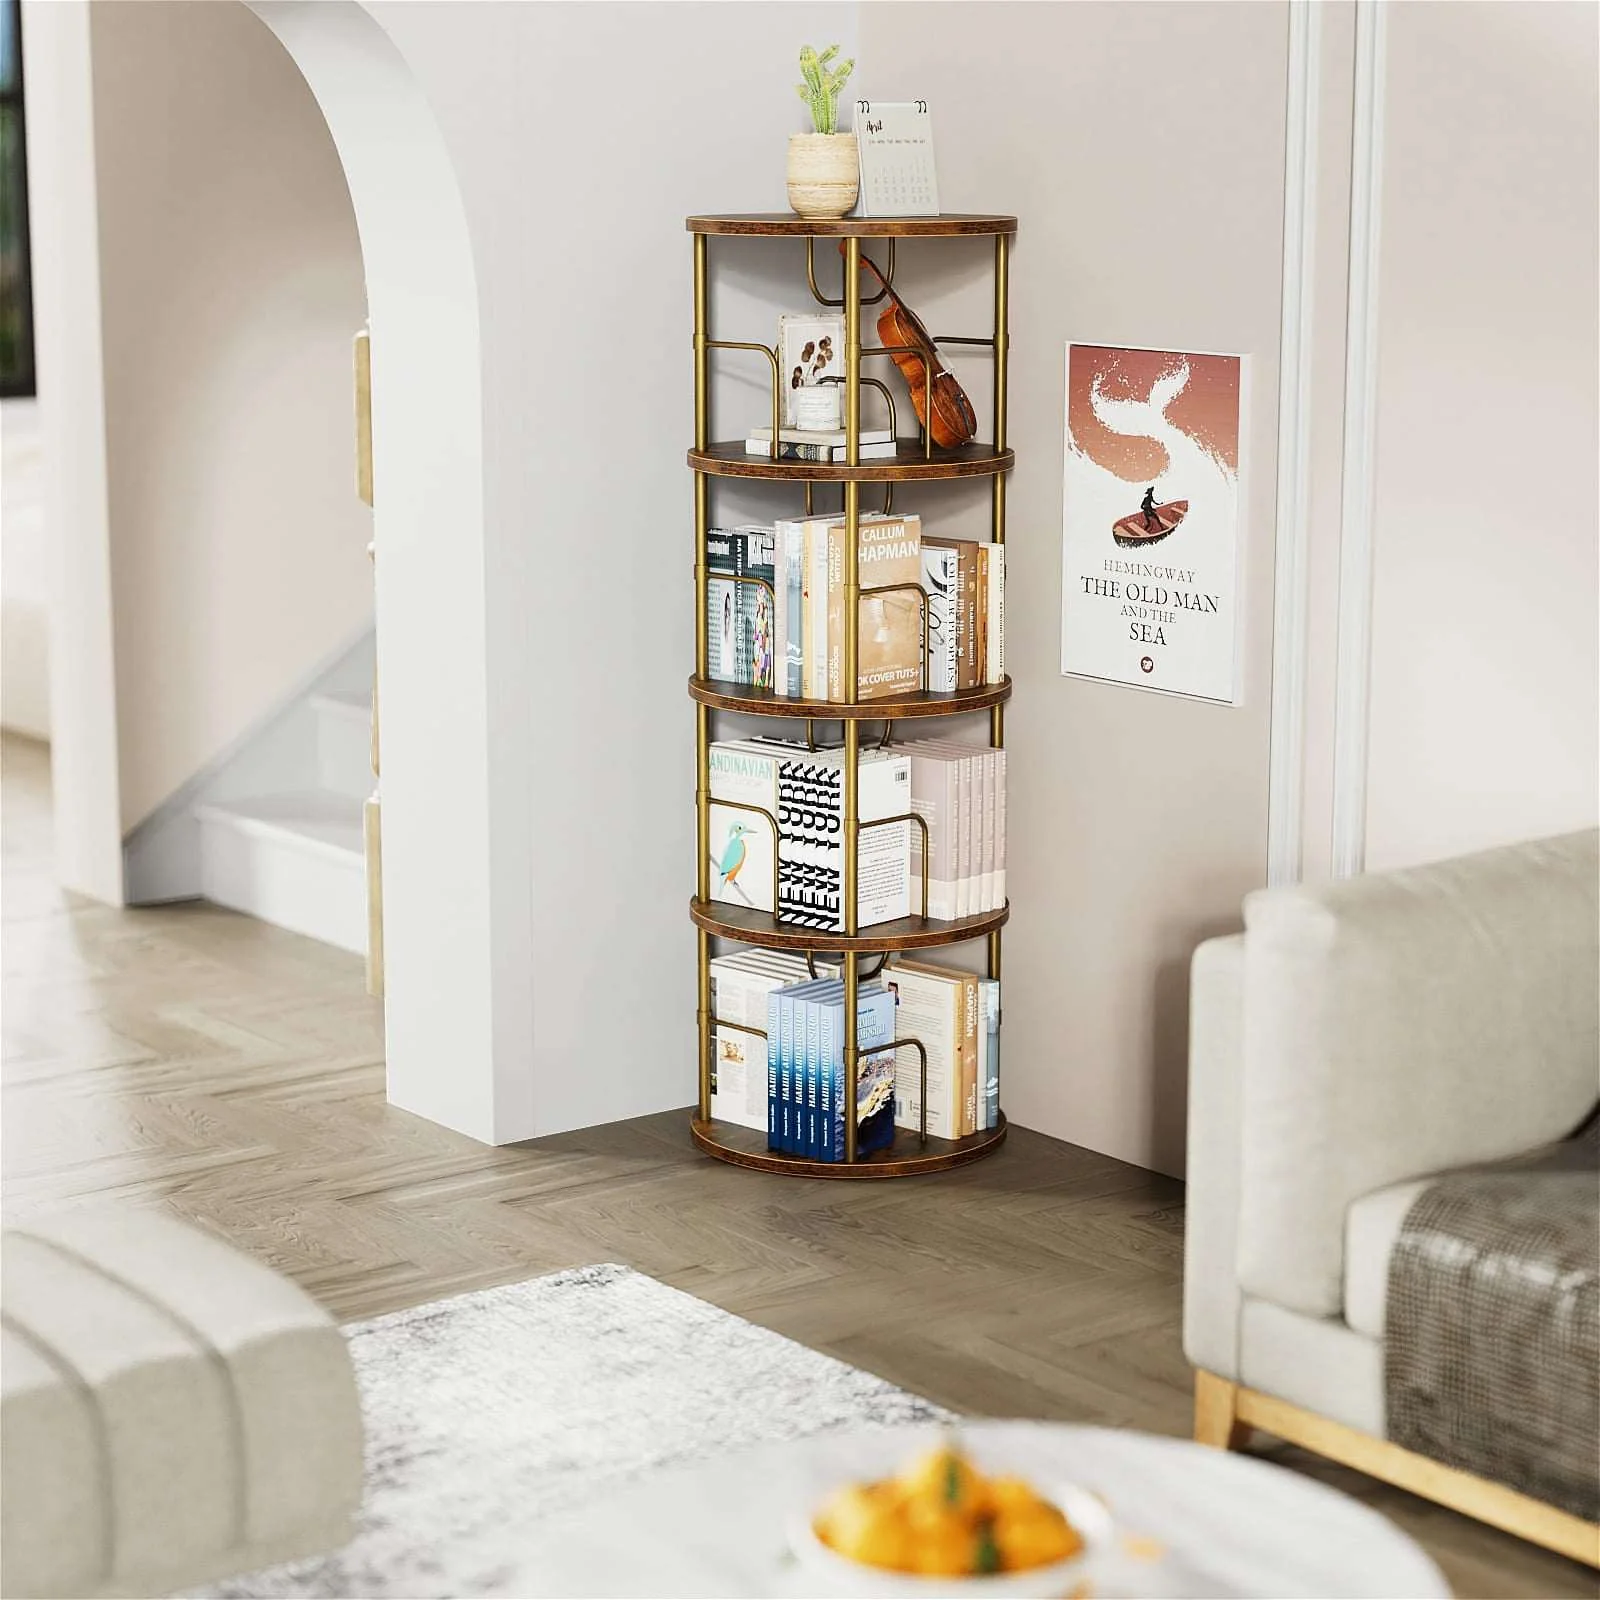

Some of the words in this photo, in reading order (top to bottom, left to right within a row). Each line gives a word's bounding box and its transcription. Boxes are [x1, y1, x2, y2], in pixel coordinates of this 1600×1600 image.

[858, 539, 919, 562] HAPMAN
[862, 524, 905, 542] CALLUM
[1080, 575, 1121, 599] THE
[1125, 582, 1168, 605] OLD
[1173, 591, 1221, 613] MAN
[1104, 559, 1195, 583] HEMINGWAY
[1120, 604, 1147, 619] AND
[1149, 608, 1177, 624] THE
[1129, 622, 1167, 646] SEA
[858, 675, 868, 687] OK
[869, 671, 895, 684] COVER
[711, 752, 772, 780] ANDINAVIAN
[779, 761, 791, 842] YORK
[791, 763, 803, 844] YORK
[803, 765, 816, 846] YORK
[815, 767, 828, 848] YORK
[827, 769, 840, 851] YORK
[779, 859, 791, 922] NEW
[791, 860, 803, 924] NEW
[803, 862, 816, 927] NEW
[815, 865, 828, 929] NEW
[827, 867, 840, 931] NEW
[966, 984, 974, 1037] CHAPMAN
